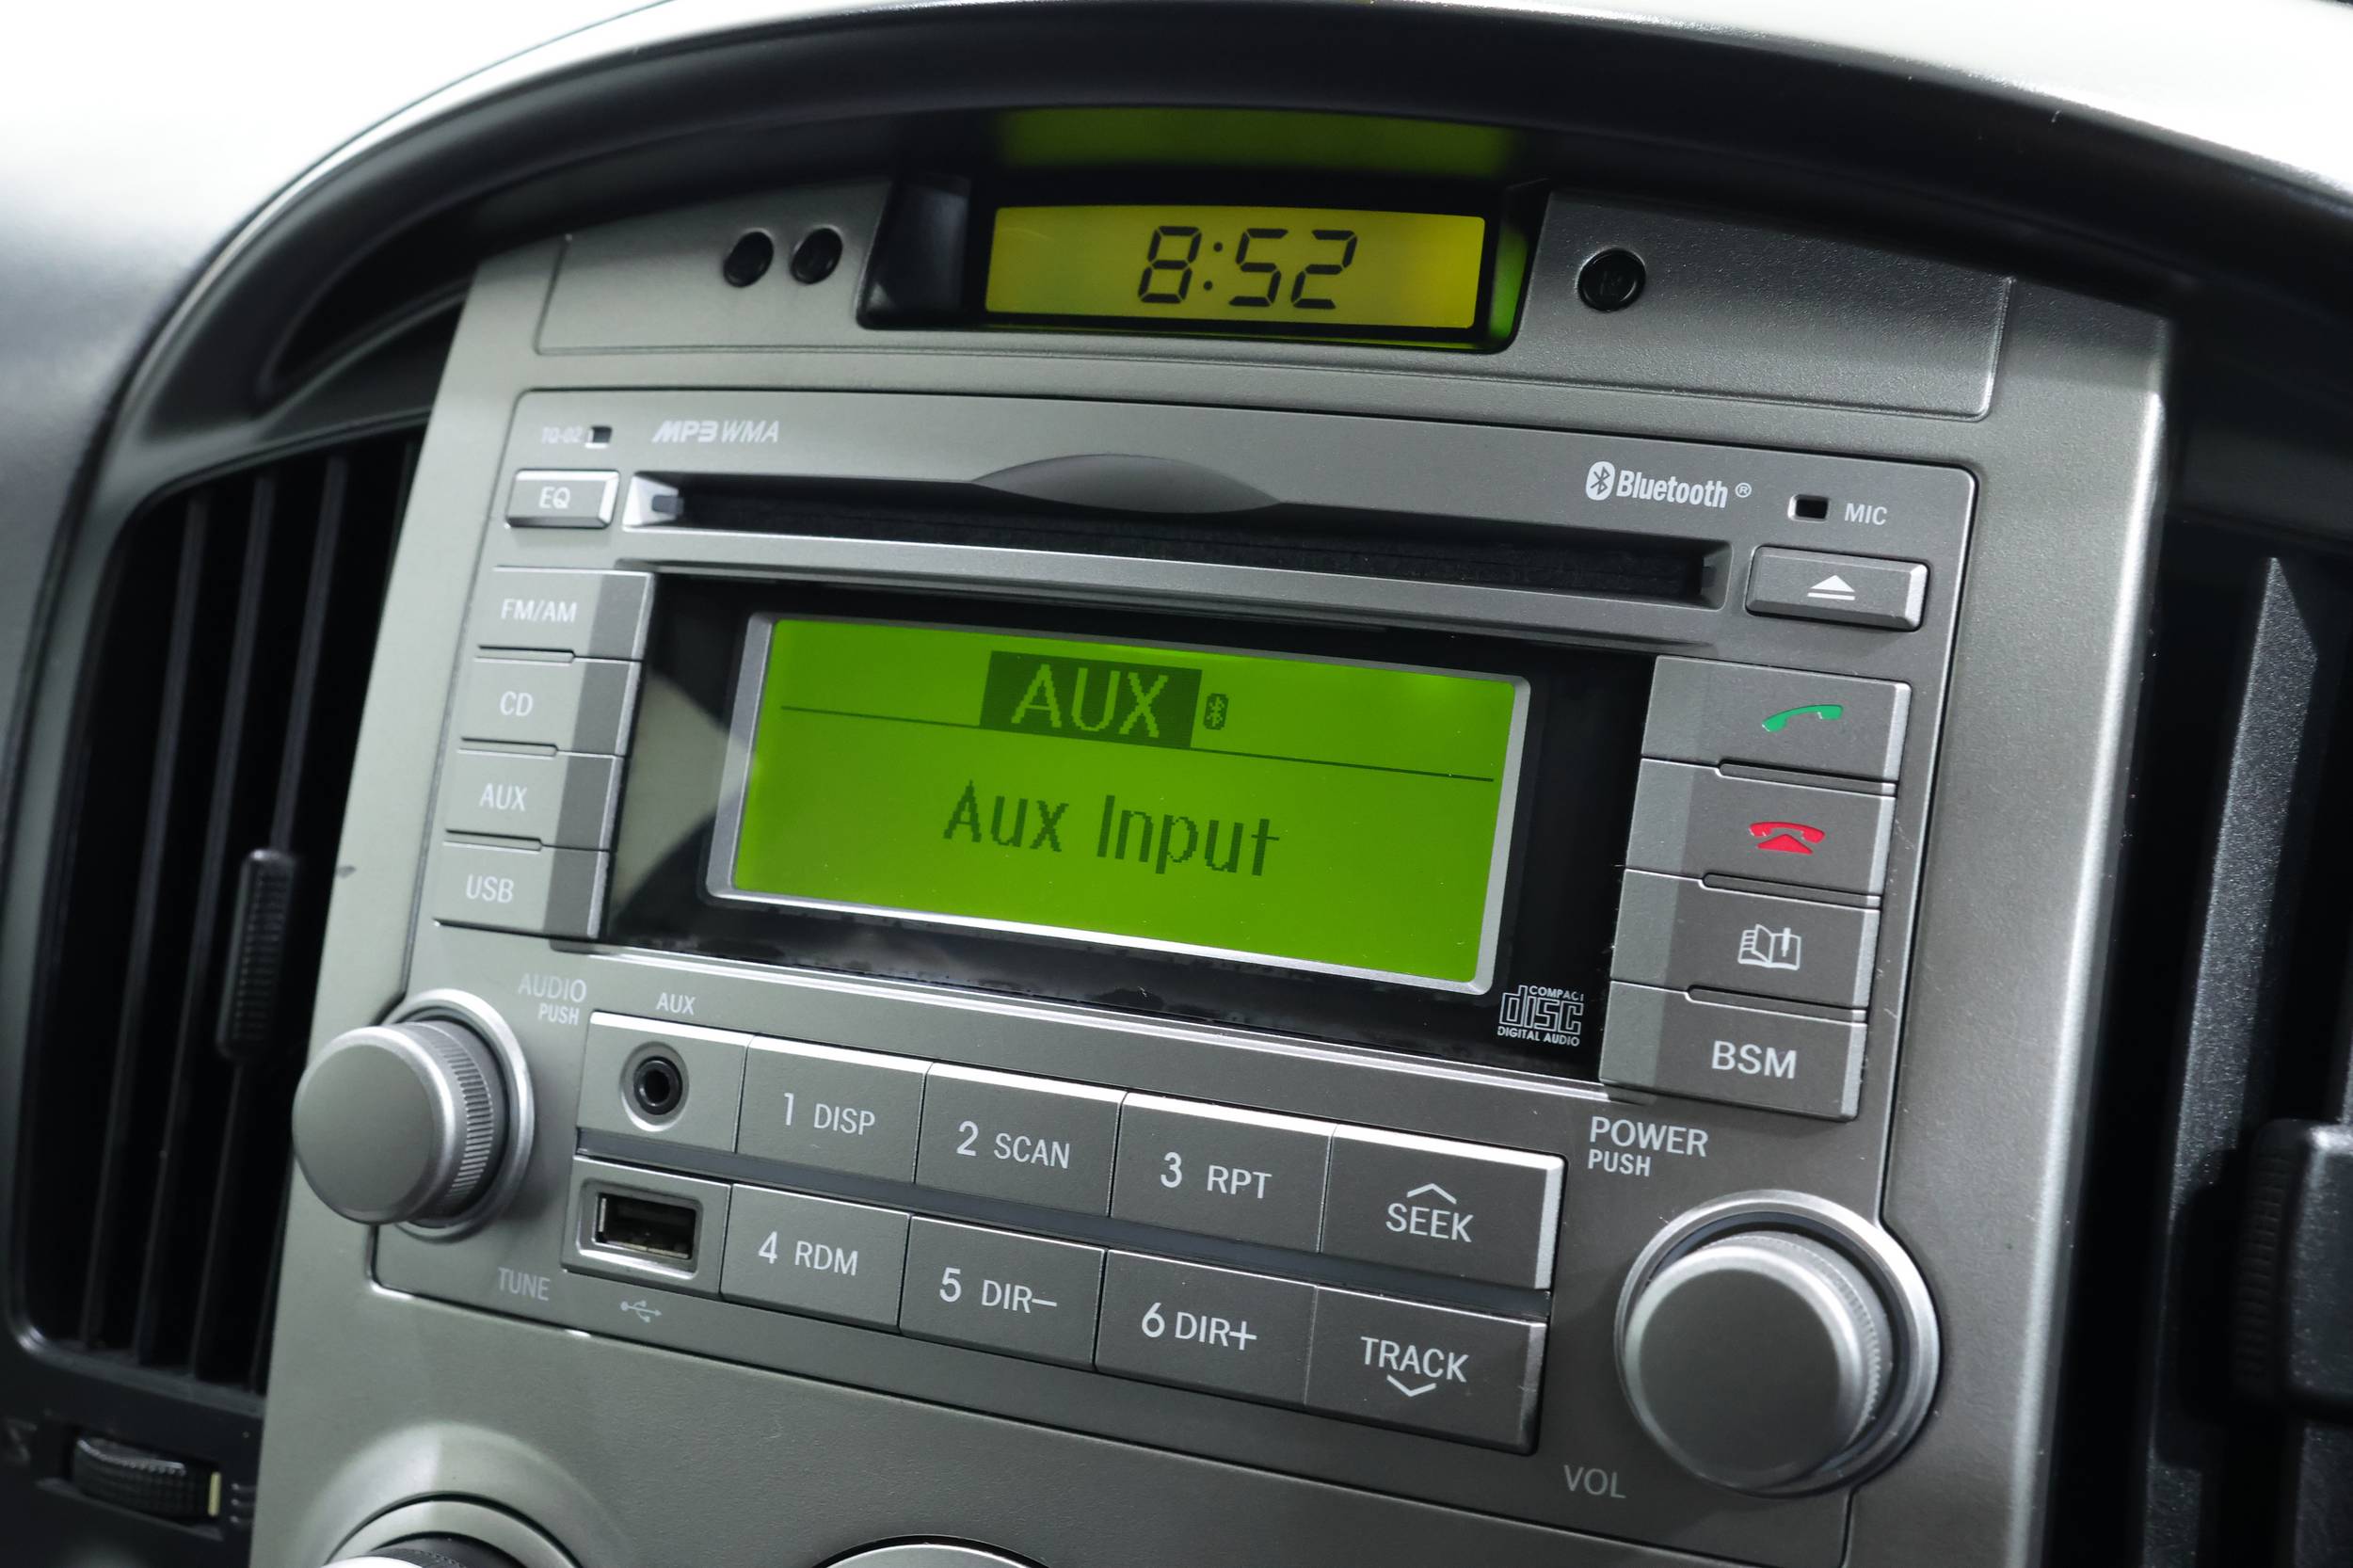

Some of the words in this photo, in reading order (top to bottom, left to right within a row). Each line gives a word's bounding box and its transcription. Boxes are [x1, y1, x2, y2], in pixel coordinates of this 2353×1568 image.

[1138, 226, 1357, 310] 8:52
[651, 420, 719, 442] MP3
[721, 420, 779, 442] WMA
[539, 487, 570, 509] EQ
[1845, 503, 1888, 525] MIC
[500, 599, 577, 622] FM/AM
[499, 692, 533, 716] CD
[1011, 664, 1169, 738] AUX
[479, 783, 527, 811] AUX
[944, 780, 1069, 852] Aux
[1097, 795, 1280, 876] Input
[466, 874, 515, 903] USB
[519, 973, 587, 1003] AUDIO
[656, 992, 696, 1016] AUX
[538, 1002, 580, 1025] PUSH
[1497, 1026, 1541, 1042] DIGITAL
[1544, 1032, 1580, 1047] AUDIO
[1711, 1040, 1797, 1079] BSM
[783, 1093, 794, 1126] 1
[814, 1104, 875, 1135] DISP
[956, 1121, 979, 1157] 2
[993, 1132, 1070, 1169] SCAN
[1590, 1115, 1709, 1157] POWER
[1160, 1152, 1183, 1188] 3
[1207, 1165, 1273, 1199] RPT
[1588, 1149, 1651, 1176] PUSH
[1385, 1203, 1474, 1243] SEEK
[758, 1231, 778, 1264] 4
[794, 1240, 858, 1275] RDM
[498, 1268, 552, 1301] TUNE
[939, 1267, 962, 1303] 5
[1142, 1302, 1166, 1338] 6
[1175, 1312, 1257, 1352] DIR+
[1360, 1336, 1469, 1383] TRACK
[1564, 1464, 1626, 1499] VOL
